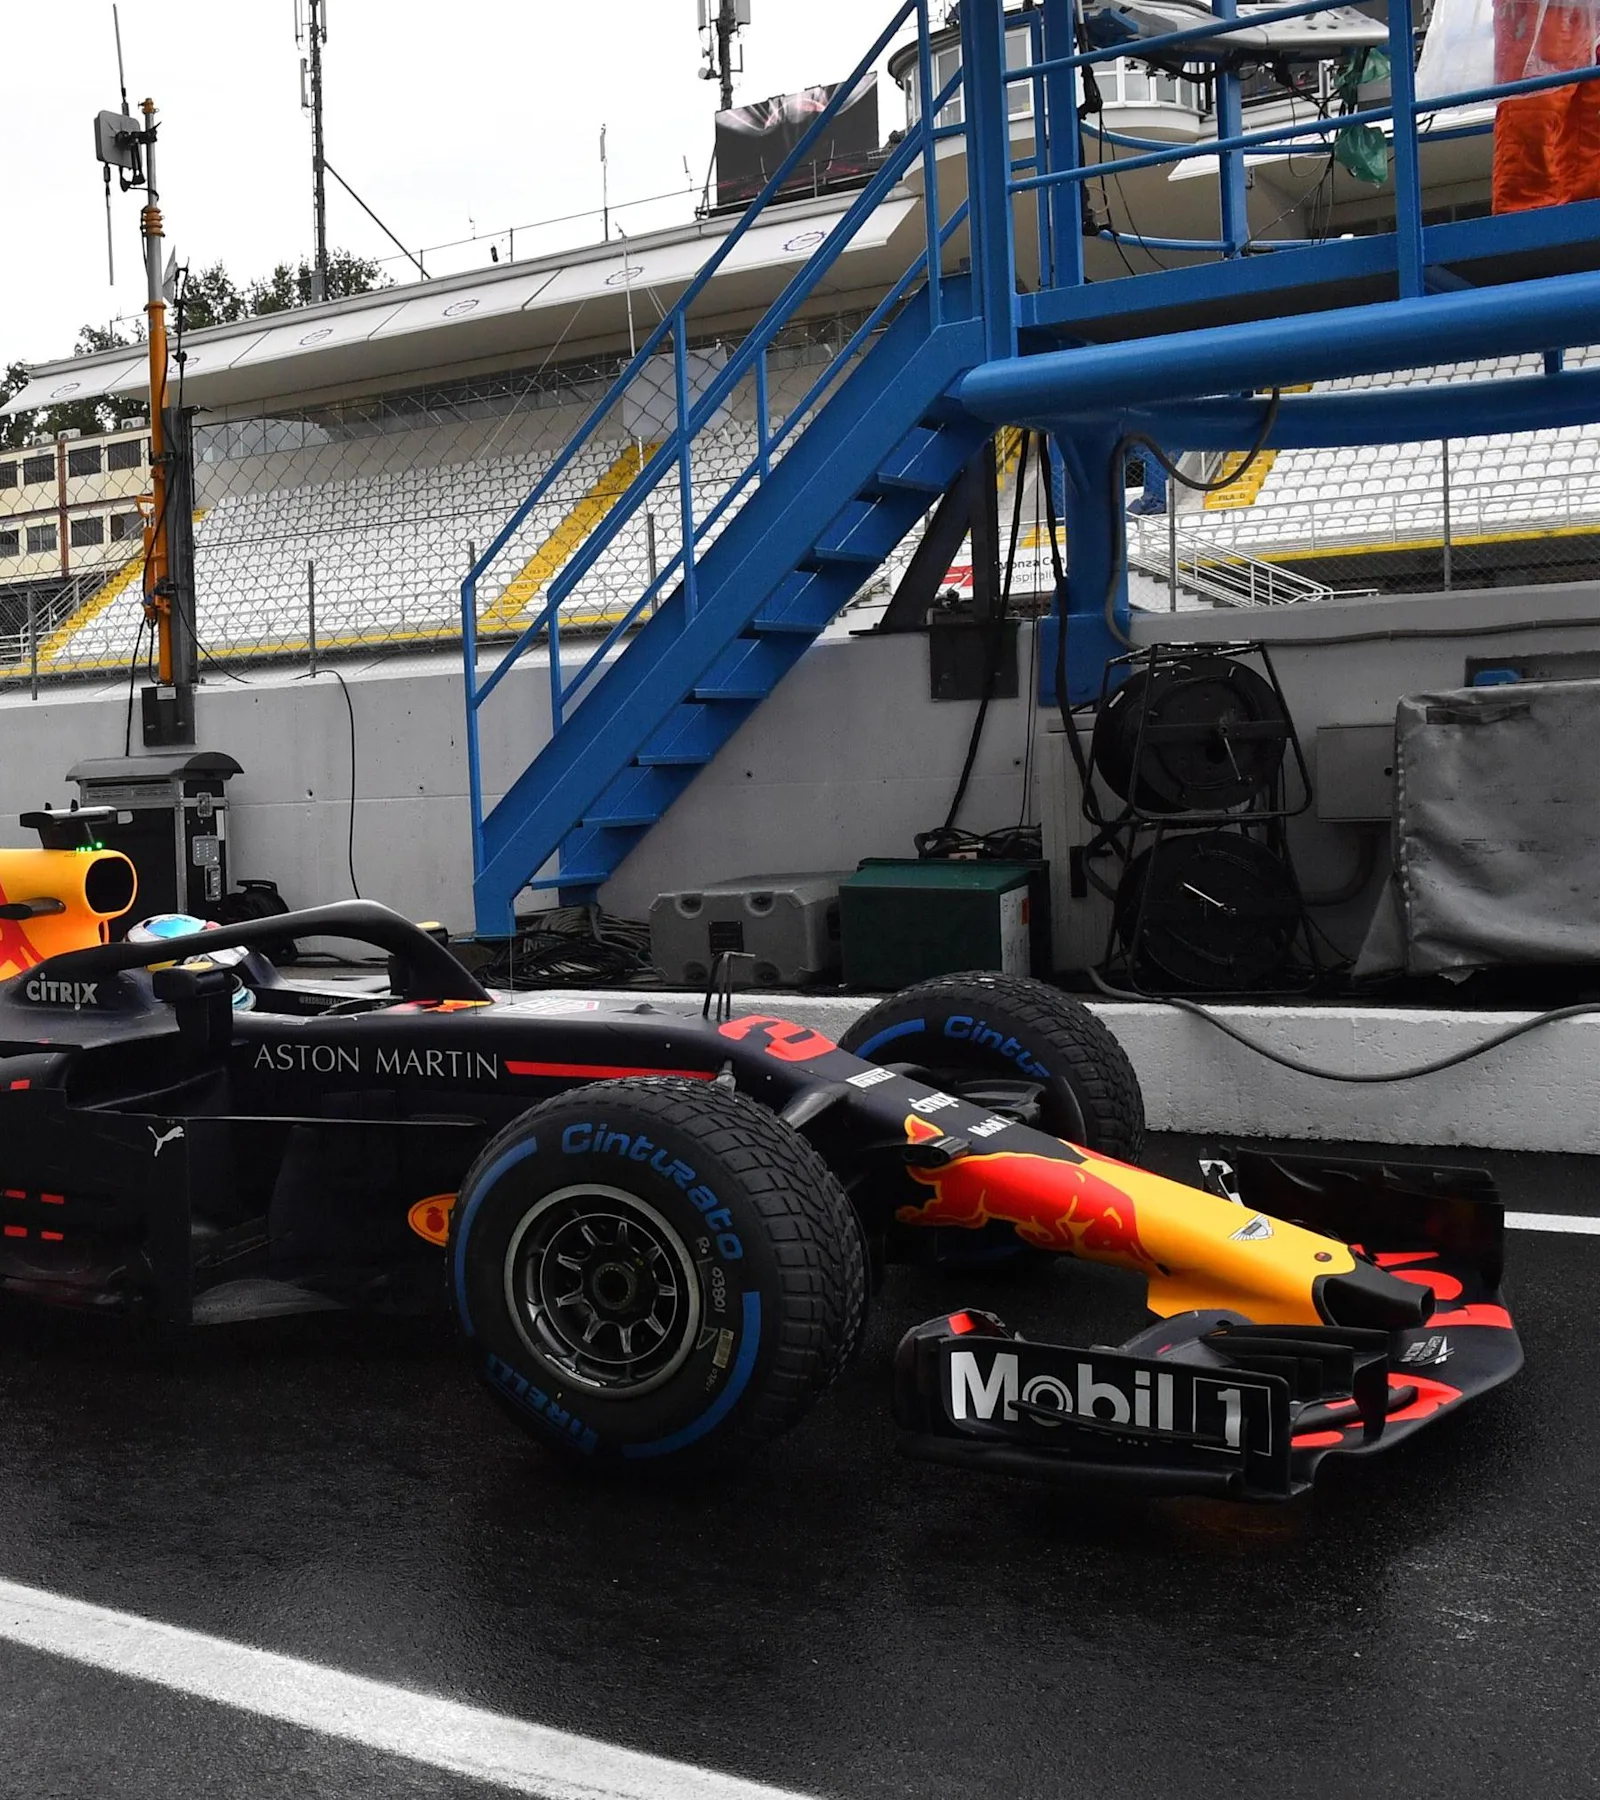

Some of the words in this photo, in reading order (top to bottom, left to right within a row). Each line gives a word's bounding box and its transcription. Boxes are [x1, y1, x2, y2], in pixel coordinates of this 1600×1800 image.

[254, 1043, 360, 1074] ASTON
[376, 1047, 499, 1080] MARTIN
[845, 1067, 897, 1088] PIRELLI
[967, 1115, 1002, 1138] Mobil
[951, 1351, 1174, 1431] Mobil
[1217, 1388, 1241, 1448] 1
